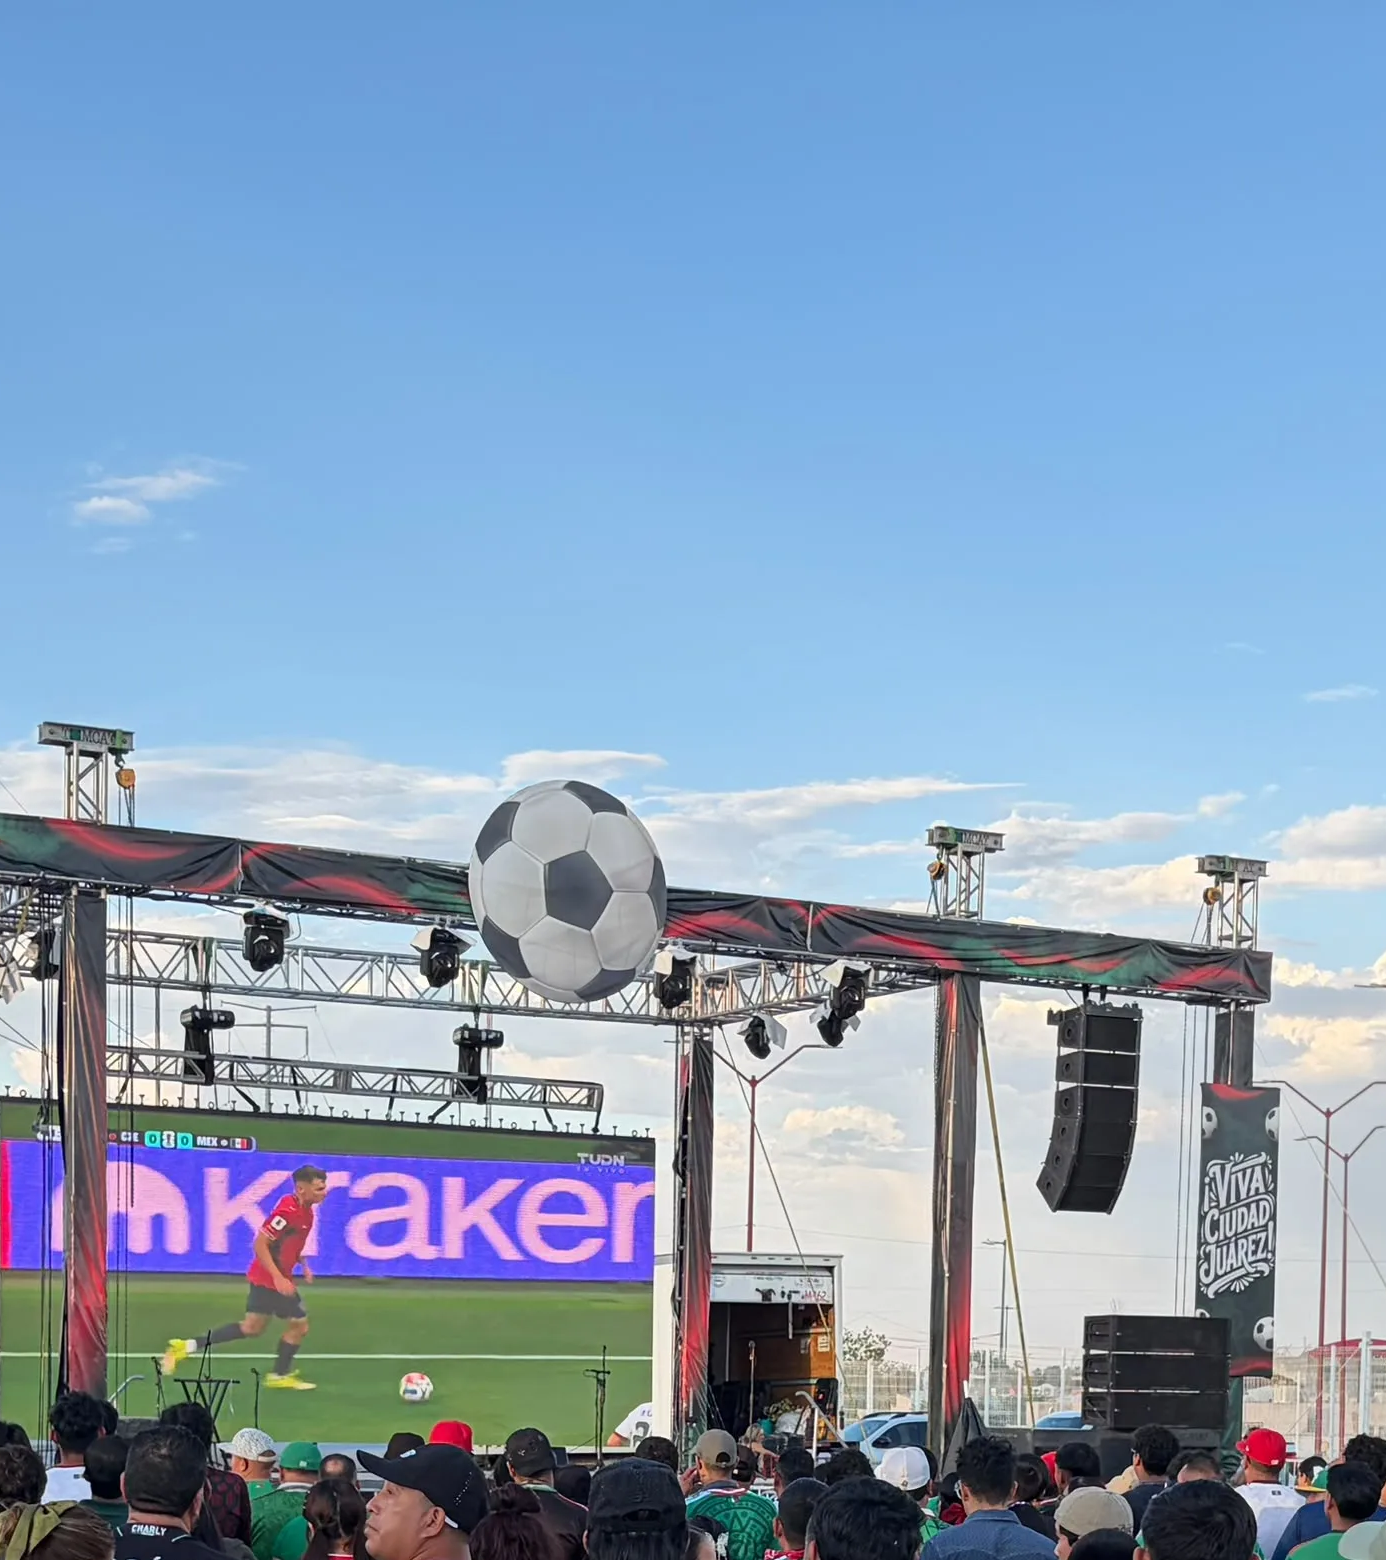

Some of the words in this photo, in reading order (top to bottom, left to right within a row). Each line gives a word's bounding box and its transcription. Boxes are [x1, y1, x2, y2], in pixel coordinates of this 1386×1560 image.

[196, 1136, 219, 1147] MEX
[576, 1152, 625, 1167] TUDN
[1203, 1164, 1266, 1212] ¡VIVA
[1204, 1200, 1270, 1244] CIUDAD
[1199, 1221, 1274, 1284] JUÁREZ!
[131, 1524, 167, 1536] CHARLY
